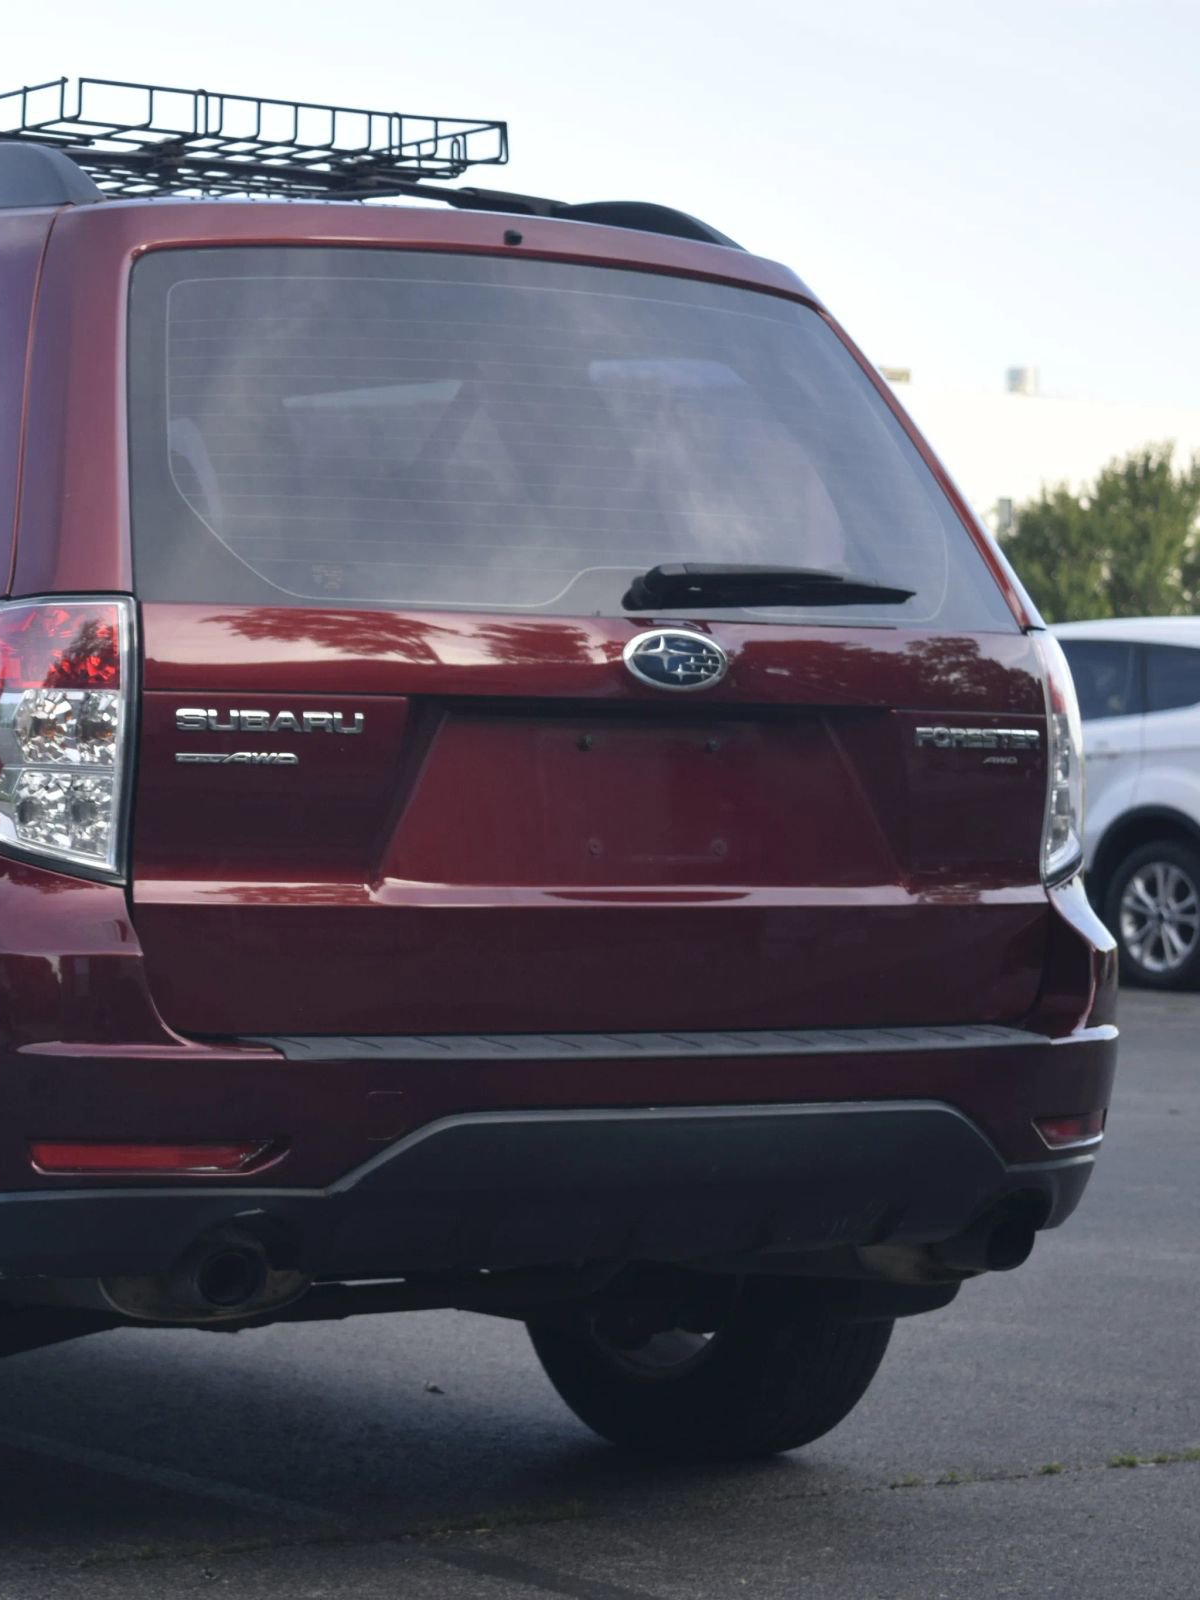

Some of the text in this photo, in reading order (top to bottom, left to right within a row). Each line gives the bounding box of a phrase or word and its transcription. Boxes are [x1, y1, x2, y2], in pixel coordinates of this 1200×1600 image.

[175, 708, 364, 733] SUBARU
[915, 727, 1040, 749] FORESTER
[222, 752, 299, 764] AWD
[983, 756, 1018, 764] AWD
